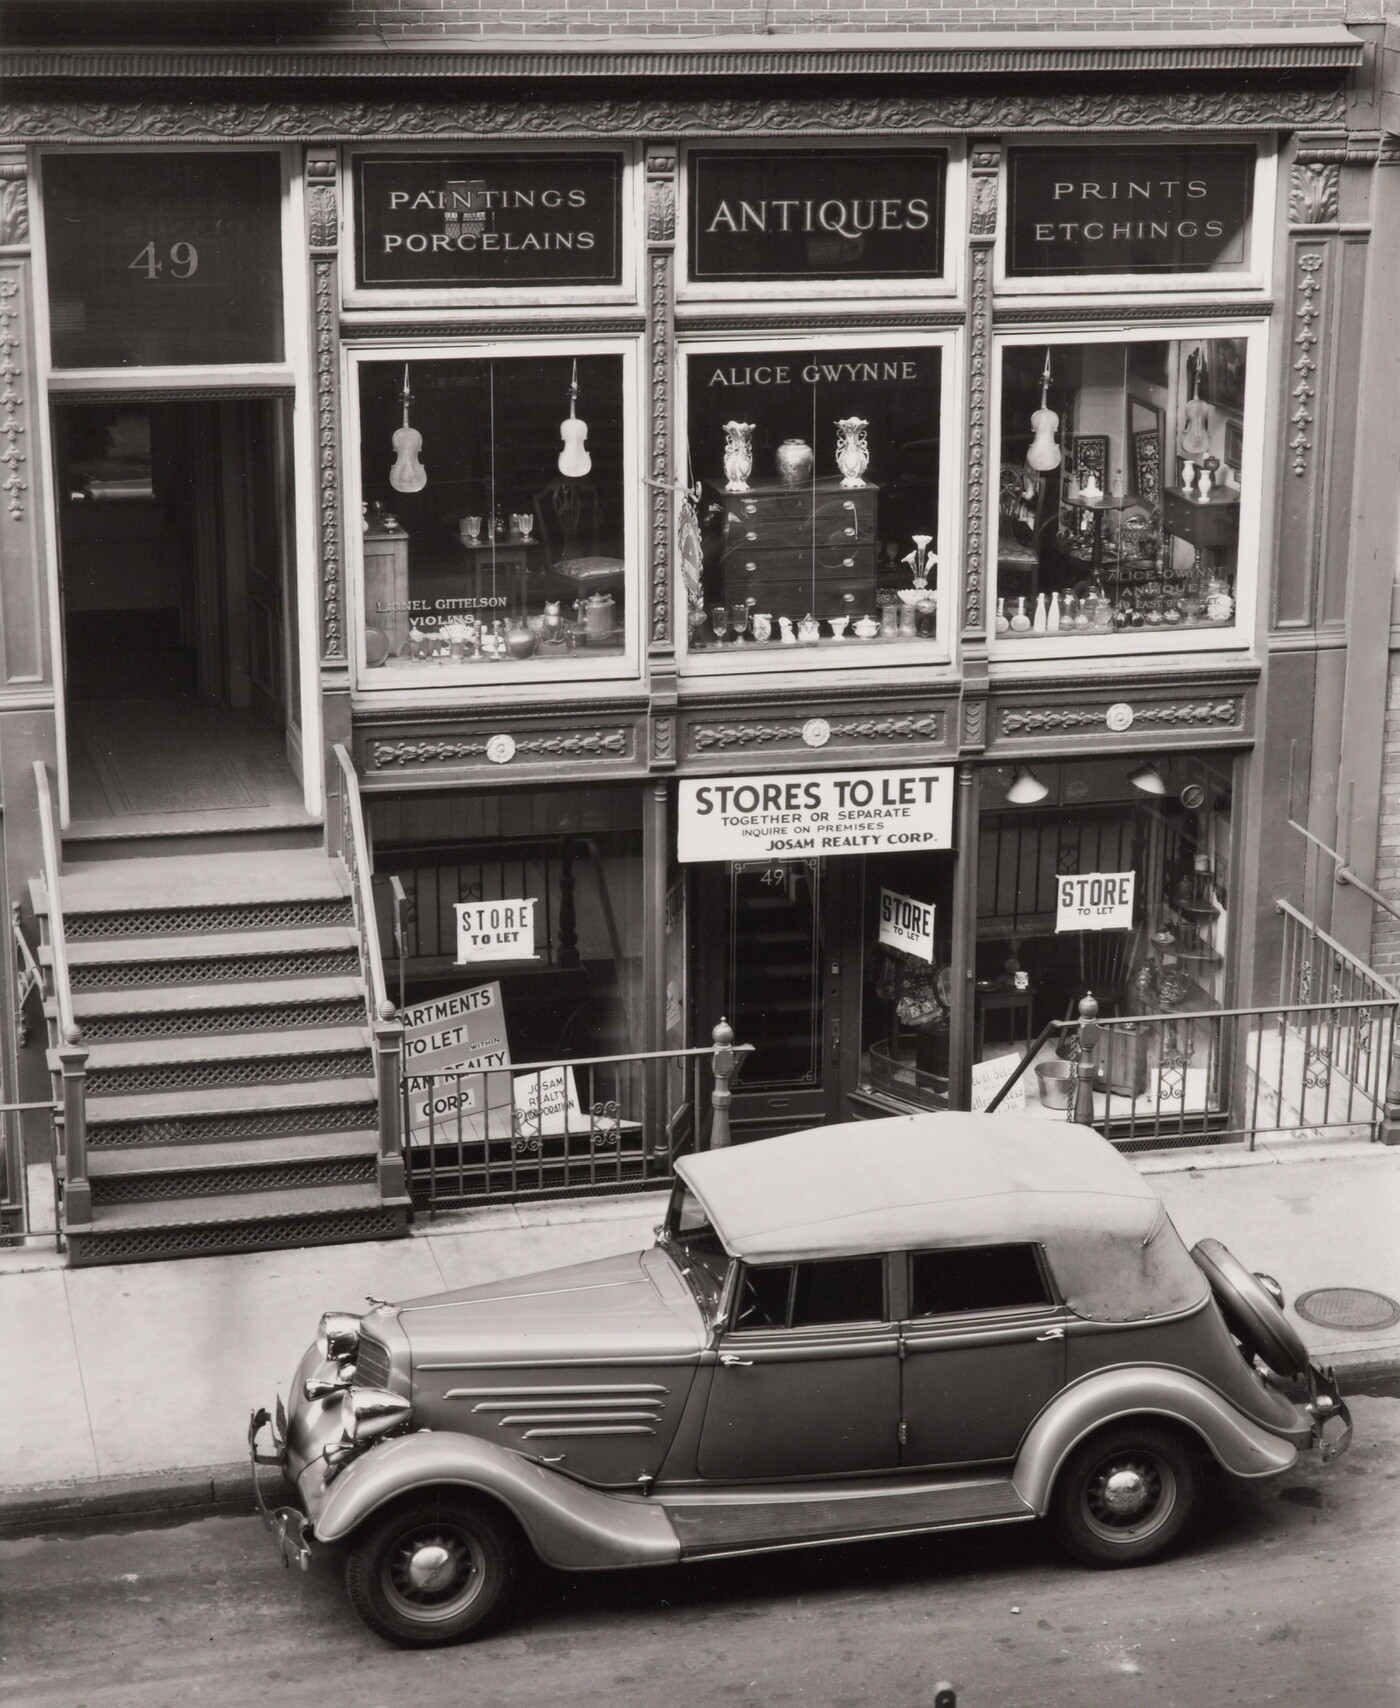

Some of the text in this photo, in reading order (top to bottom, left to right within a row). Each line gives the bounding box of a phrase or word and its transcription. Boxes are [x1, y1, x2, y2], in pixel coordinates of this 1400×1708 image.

[388, 189, 588, 211] PAINTINGS
[1052, 180, 1208, 202] PRINTS
[706, 198, 930, 239] ANTIQUES
[1034, 220, 1224, 242] ETCHINGS
[383, 232, 596, 253] PORCELAINS
[127, 241, 200, 281] 49
[709, 362, 918, 387] ALICE GWYNNE
[1108, 570, 1155, 582] ALICE
[376, 597, 507, 614] LIONEL GITTELSON
[409, 614, 475, 627] VIOLINS
[695, 776, 939, 816] STORES TO LET
[721, 808, 911, 827] TOGETHER OR SEPARATE
[742, 821, 885, 838] INQUIRE ON PREMISES
[765, 832, 938, 851] JOSAM REALTY CORP.
[760, 868, 784, 886] 49
[1062, 878, 1131, 908] STORE
[462, 906, 528, 932] STORE
[883, 894, 931, 937] STORE
[1077, 906, 1114, 916] TO LET
[471, 931, 519, 946] TO LET
[893, 926, 903, 936] TO
[907, 931, 920, 942] LET
[394, 990, 490, 1027] ARTMENTS
[405, 1027, 463, 1057] TO LET
[470, 1037, 501, 1050] WITHIN
[422, 1092, 472, 1117] CORP.
[529, 1090, 566, 1106] RALTY
